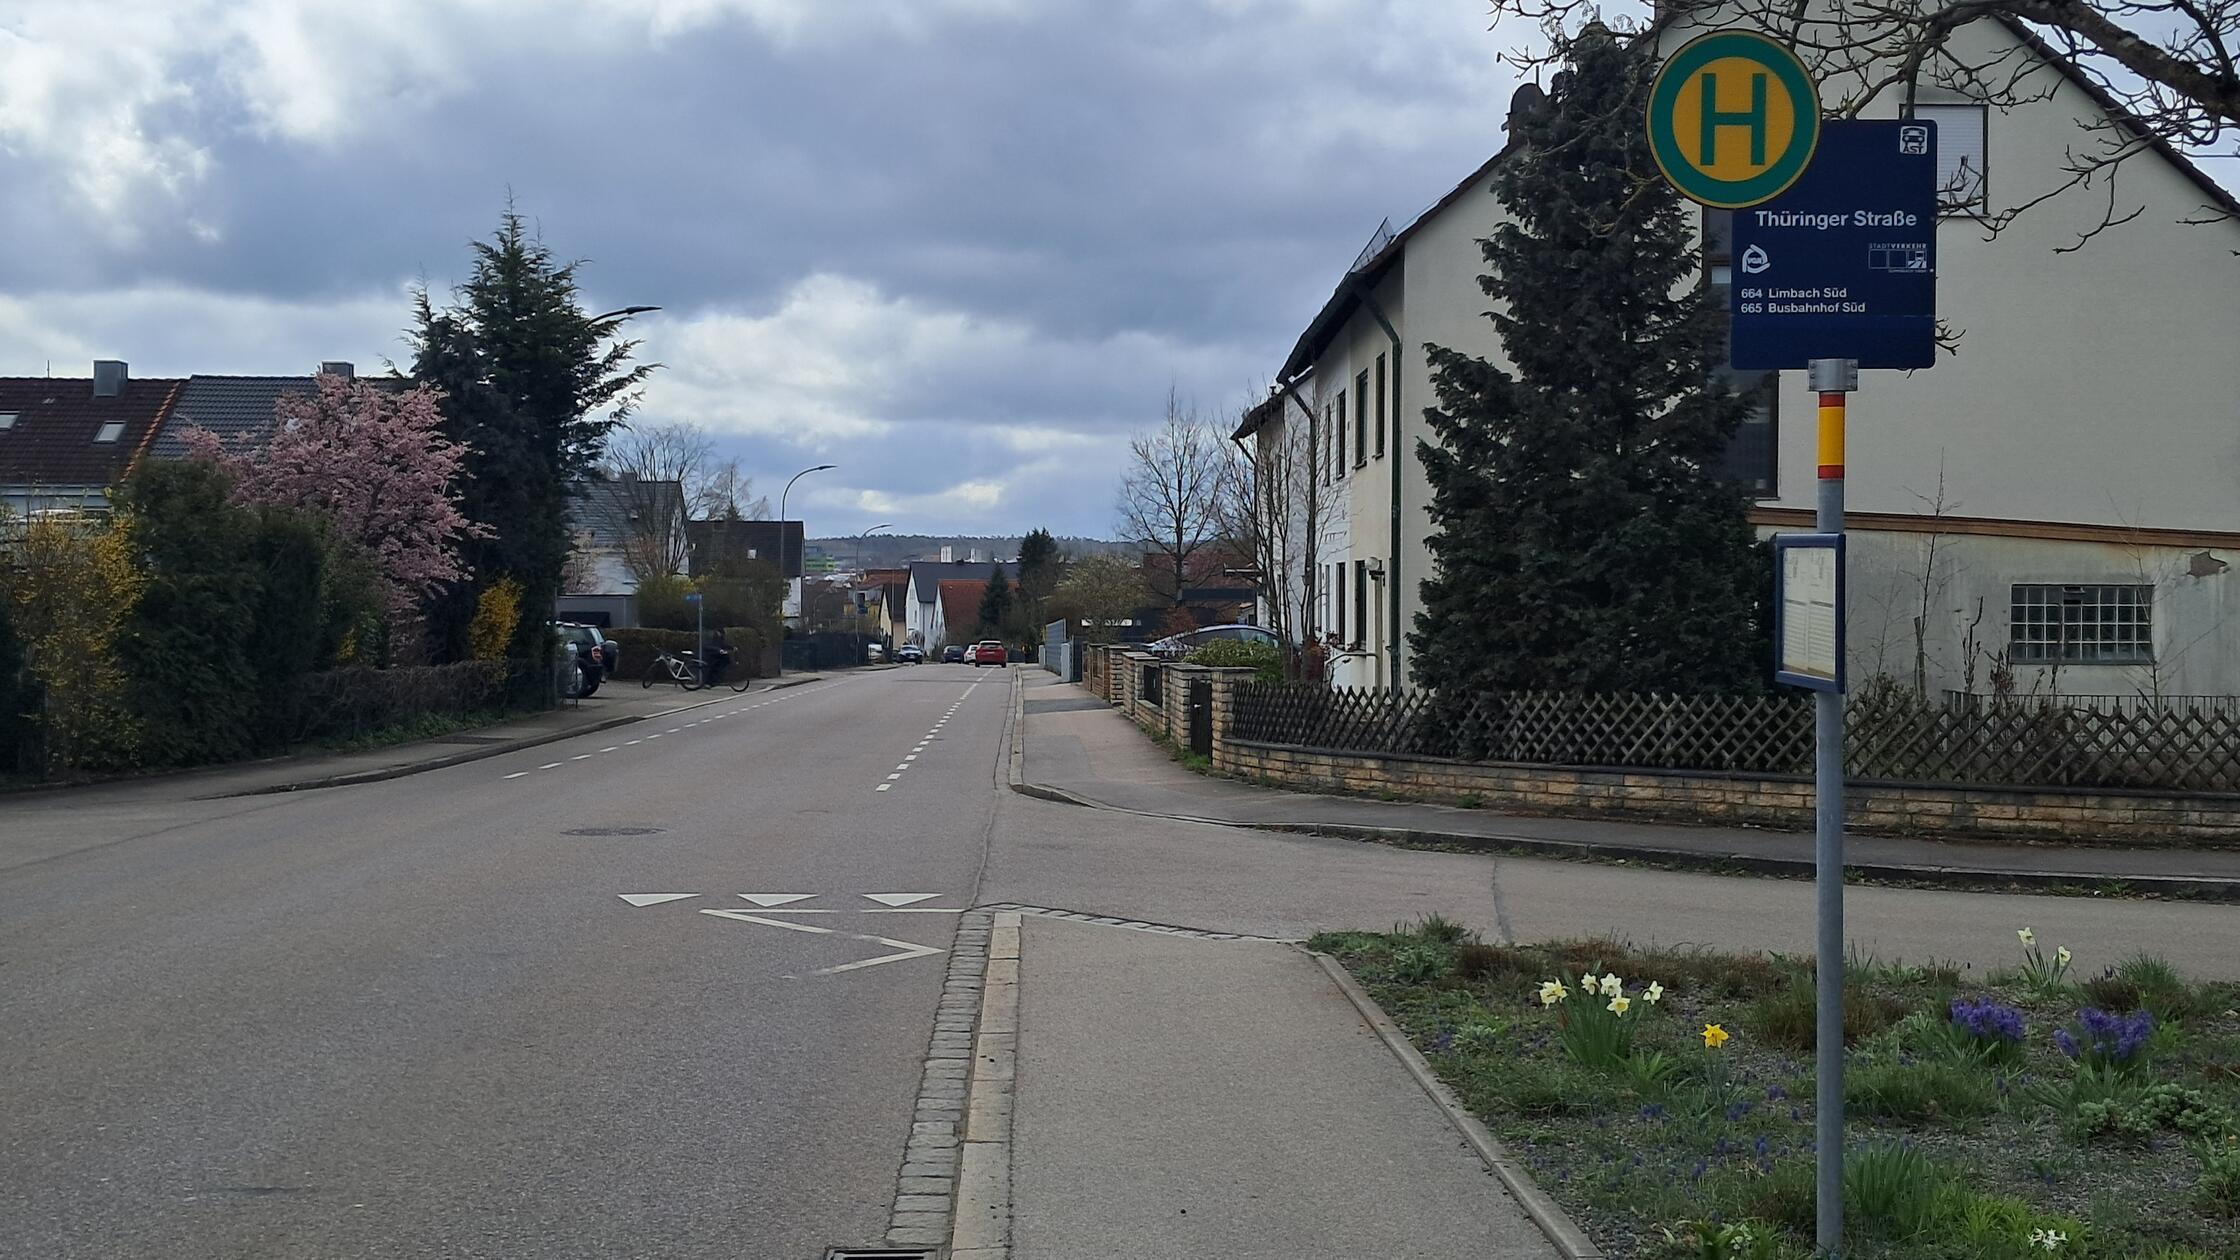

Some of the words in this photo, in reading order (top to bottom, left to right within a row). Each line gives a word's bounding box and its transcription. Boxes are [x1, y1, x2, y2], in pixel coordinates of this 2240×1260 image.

[1700, 73, 1767, 166] H
[1903, 146, 1924, 154] AST
[1755, 210, 1848, 230] Thüringer
[1854, 210, 1917, 226] Straße
[1741, 289, 1762, 298] 664
[1768, 287, 1820, 298] Limbach
[1824, 287, 1847, 298] Süd
[1741, 303, 1762, 313] 665
[1768, 302, 1839, 313] Busbahnhof
[1842, 302, 1866, 313] Süd
